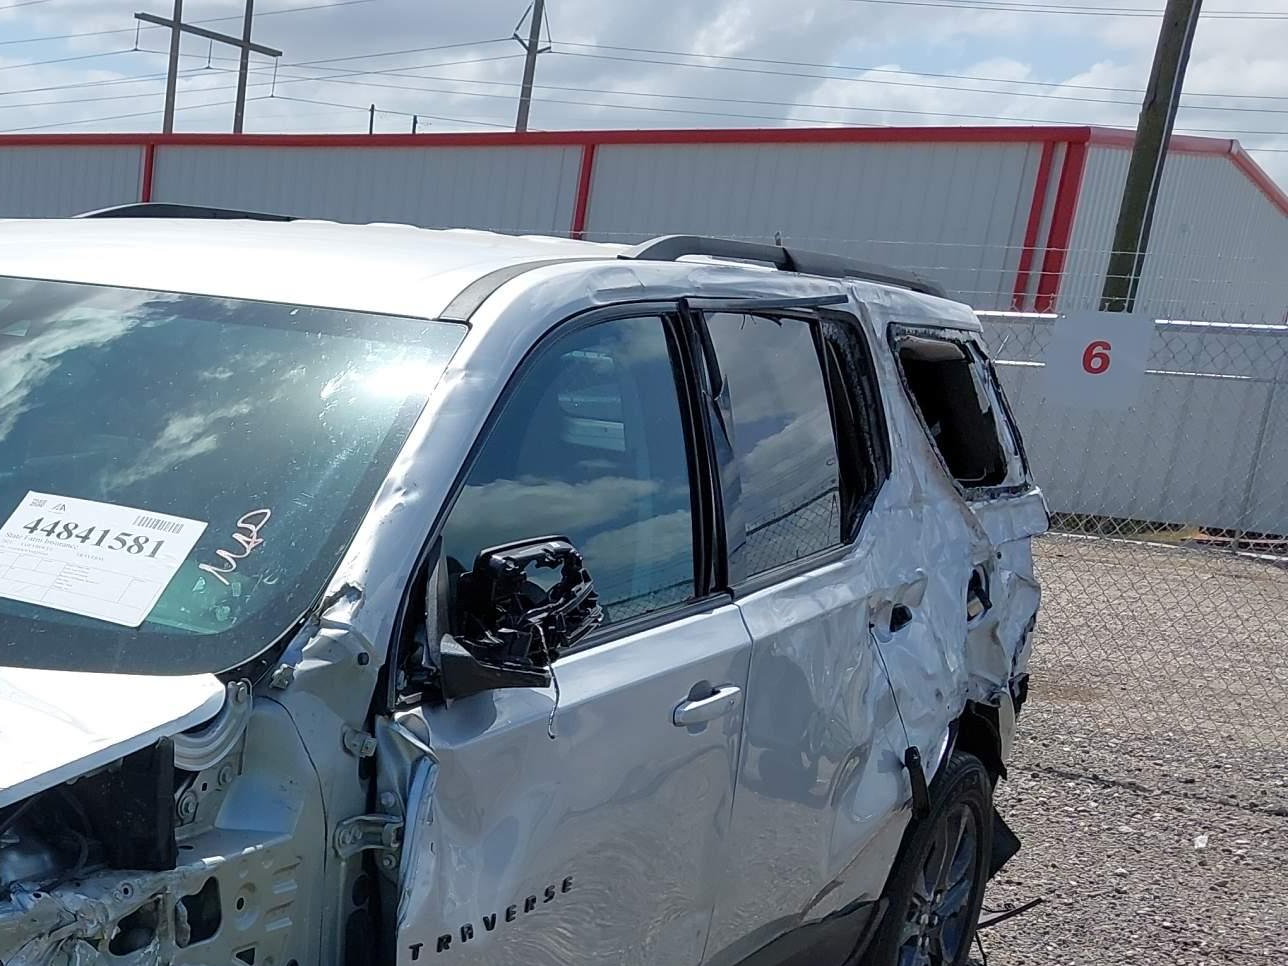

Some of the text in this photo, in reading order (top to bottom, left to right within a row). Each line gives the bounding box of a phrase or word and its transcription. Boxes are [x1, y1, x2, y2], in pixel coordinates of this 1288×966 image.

[1082, 340, 1112, 375] 6
[23, 516, 165, 559] 44841581
[408, 875, 574, 961] TRAVERSE
